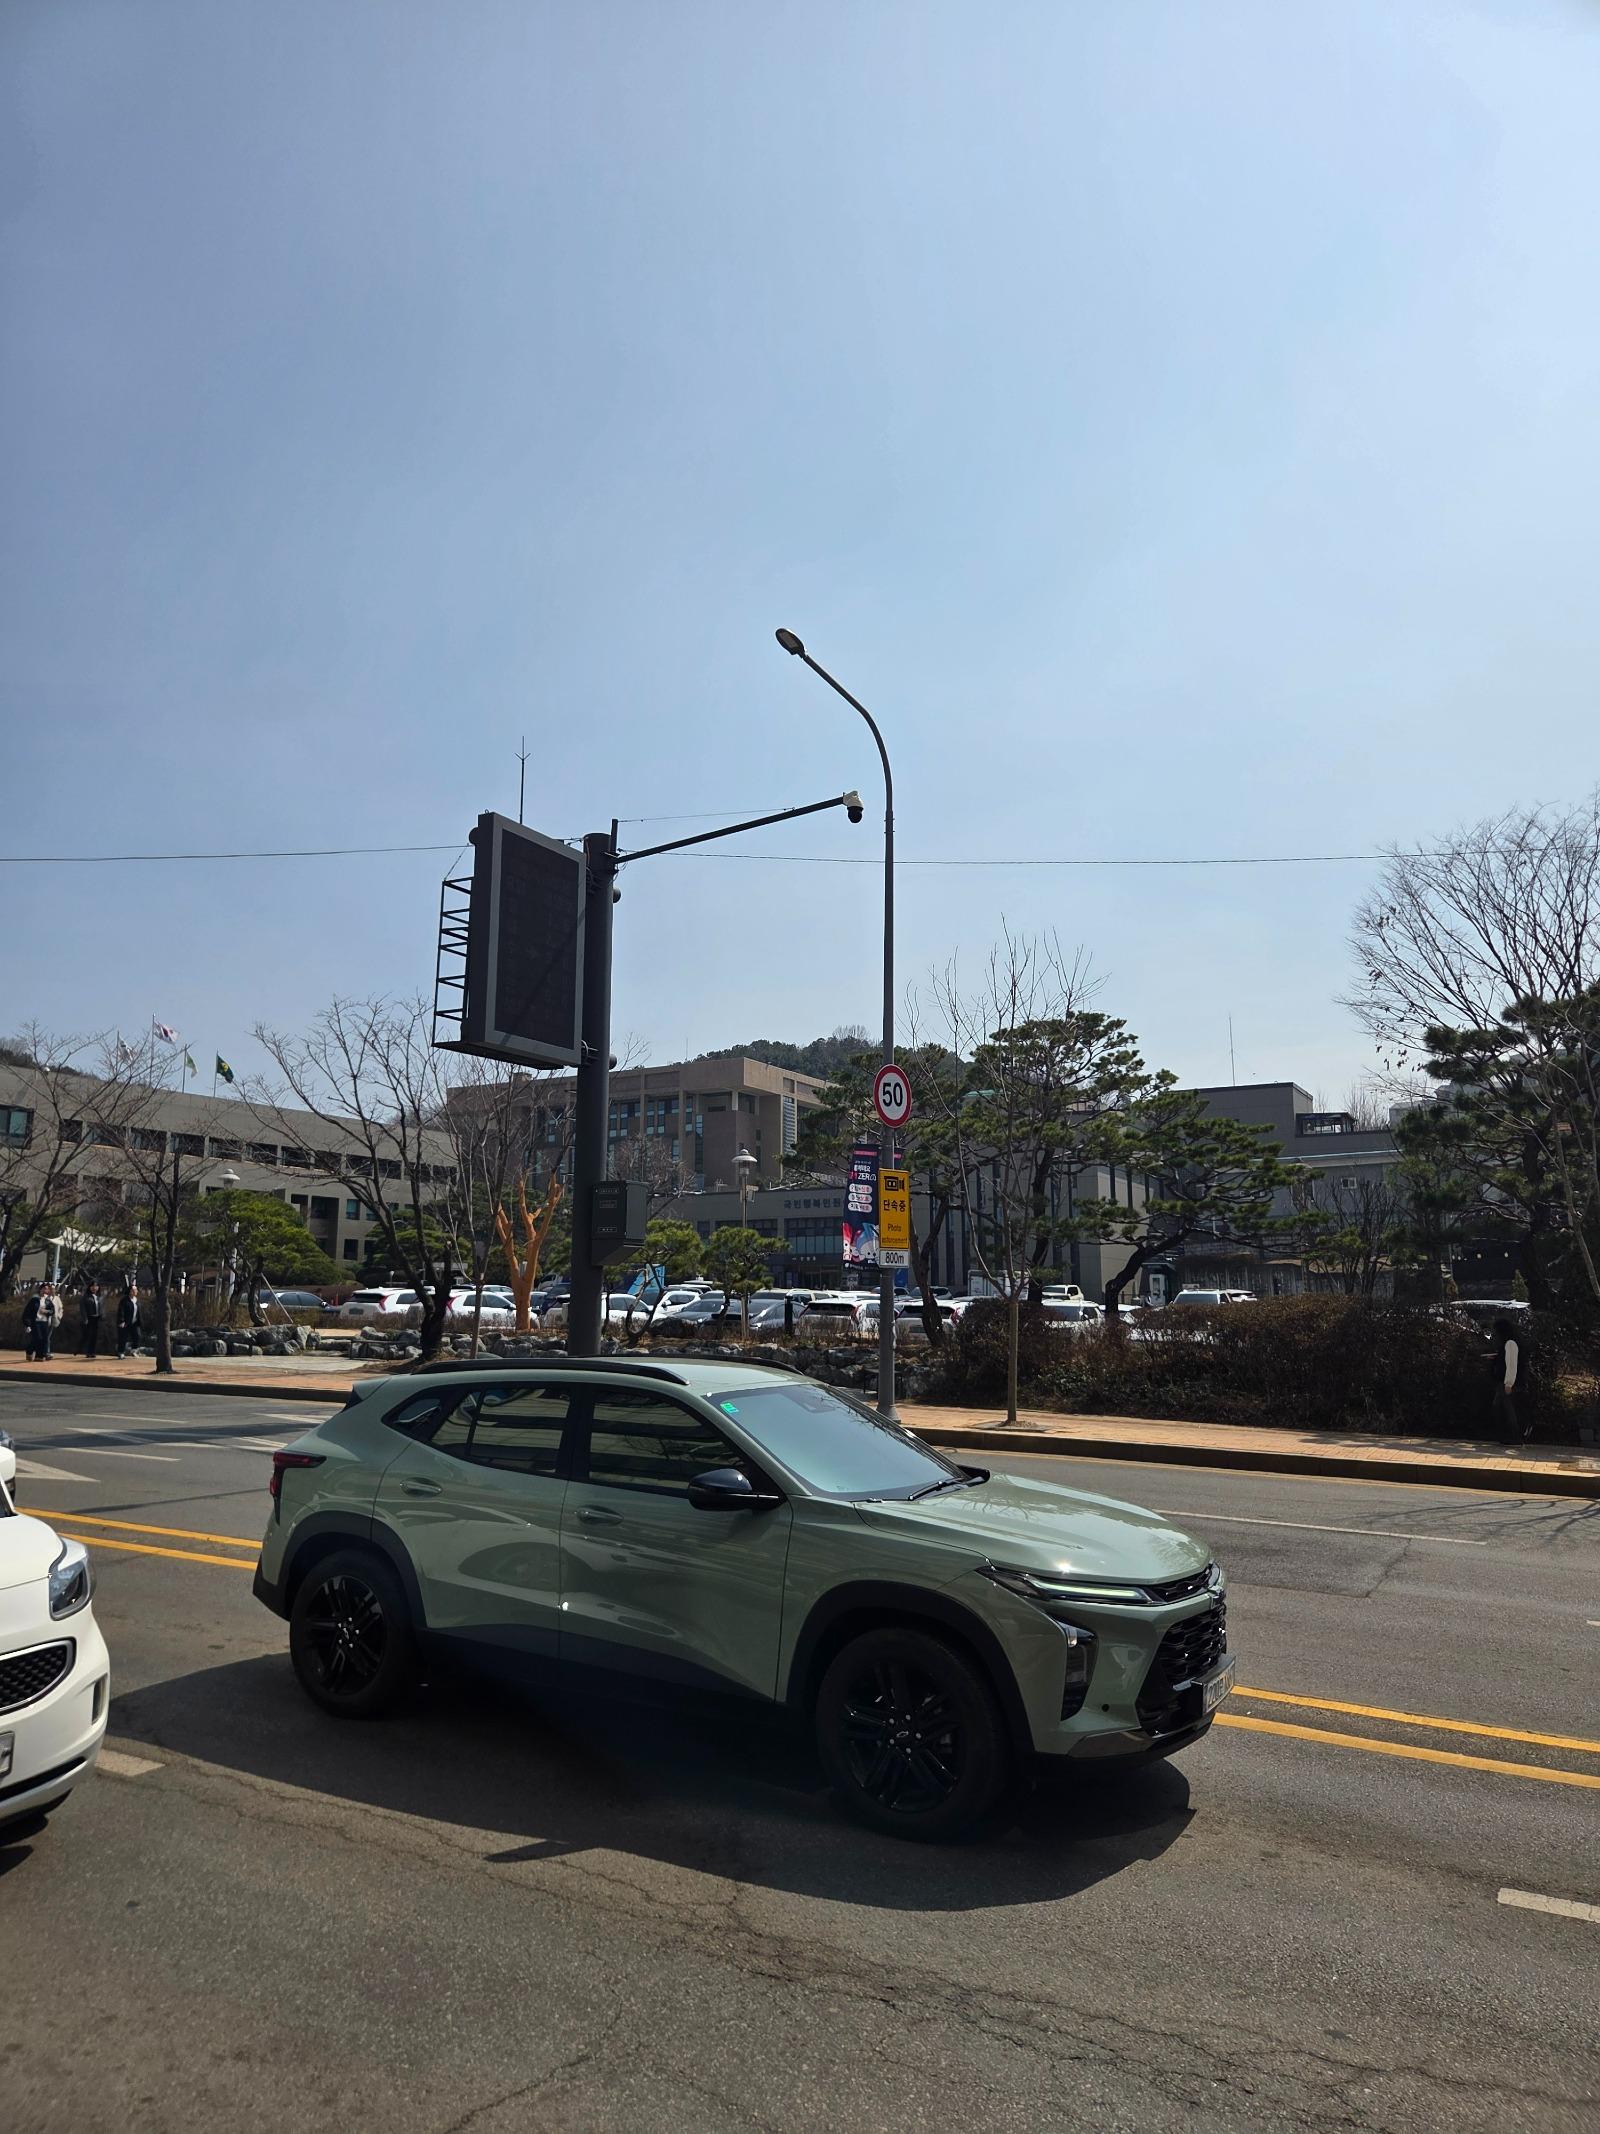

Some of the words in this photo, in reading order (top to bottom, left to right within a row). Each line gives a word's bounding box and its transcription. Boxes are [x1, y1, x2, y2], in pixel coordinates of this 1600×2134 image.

[882, 1082, 903, 1107] 50
[883, 1199, 906, 1212] 단속중
[885, 1252, 904, 1265] 800m
